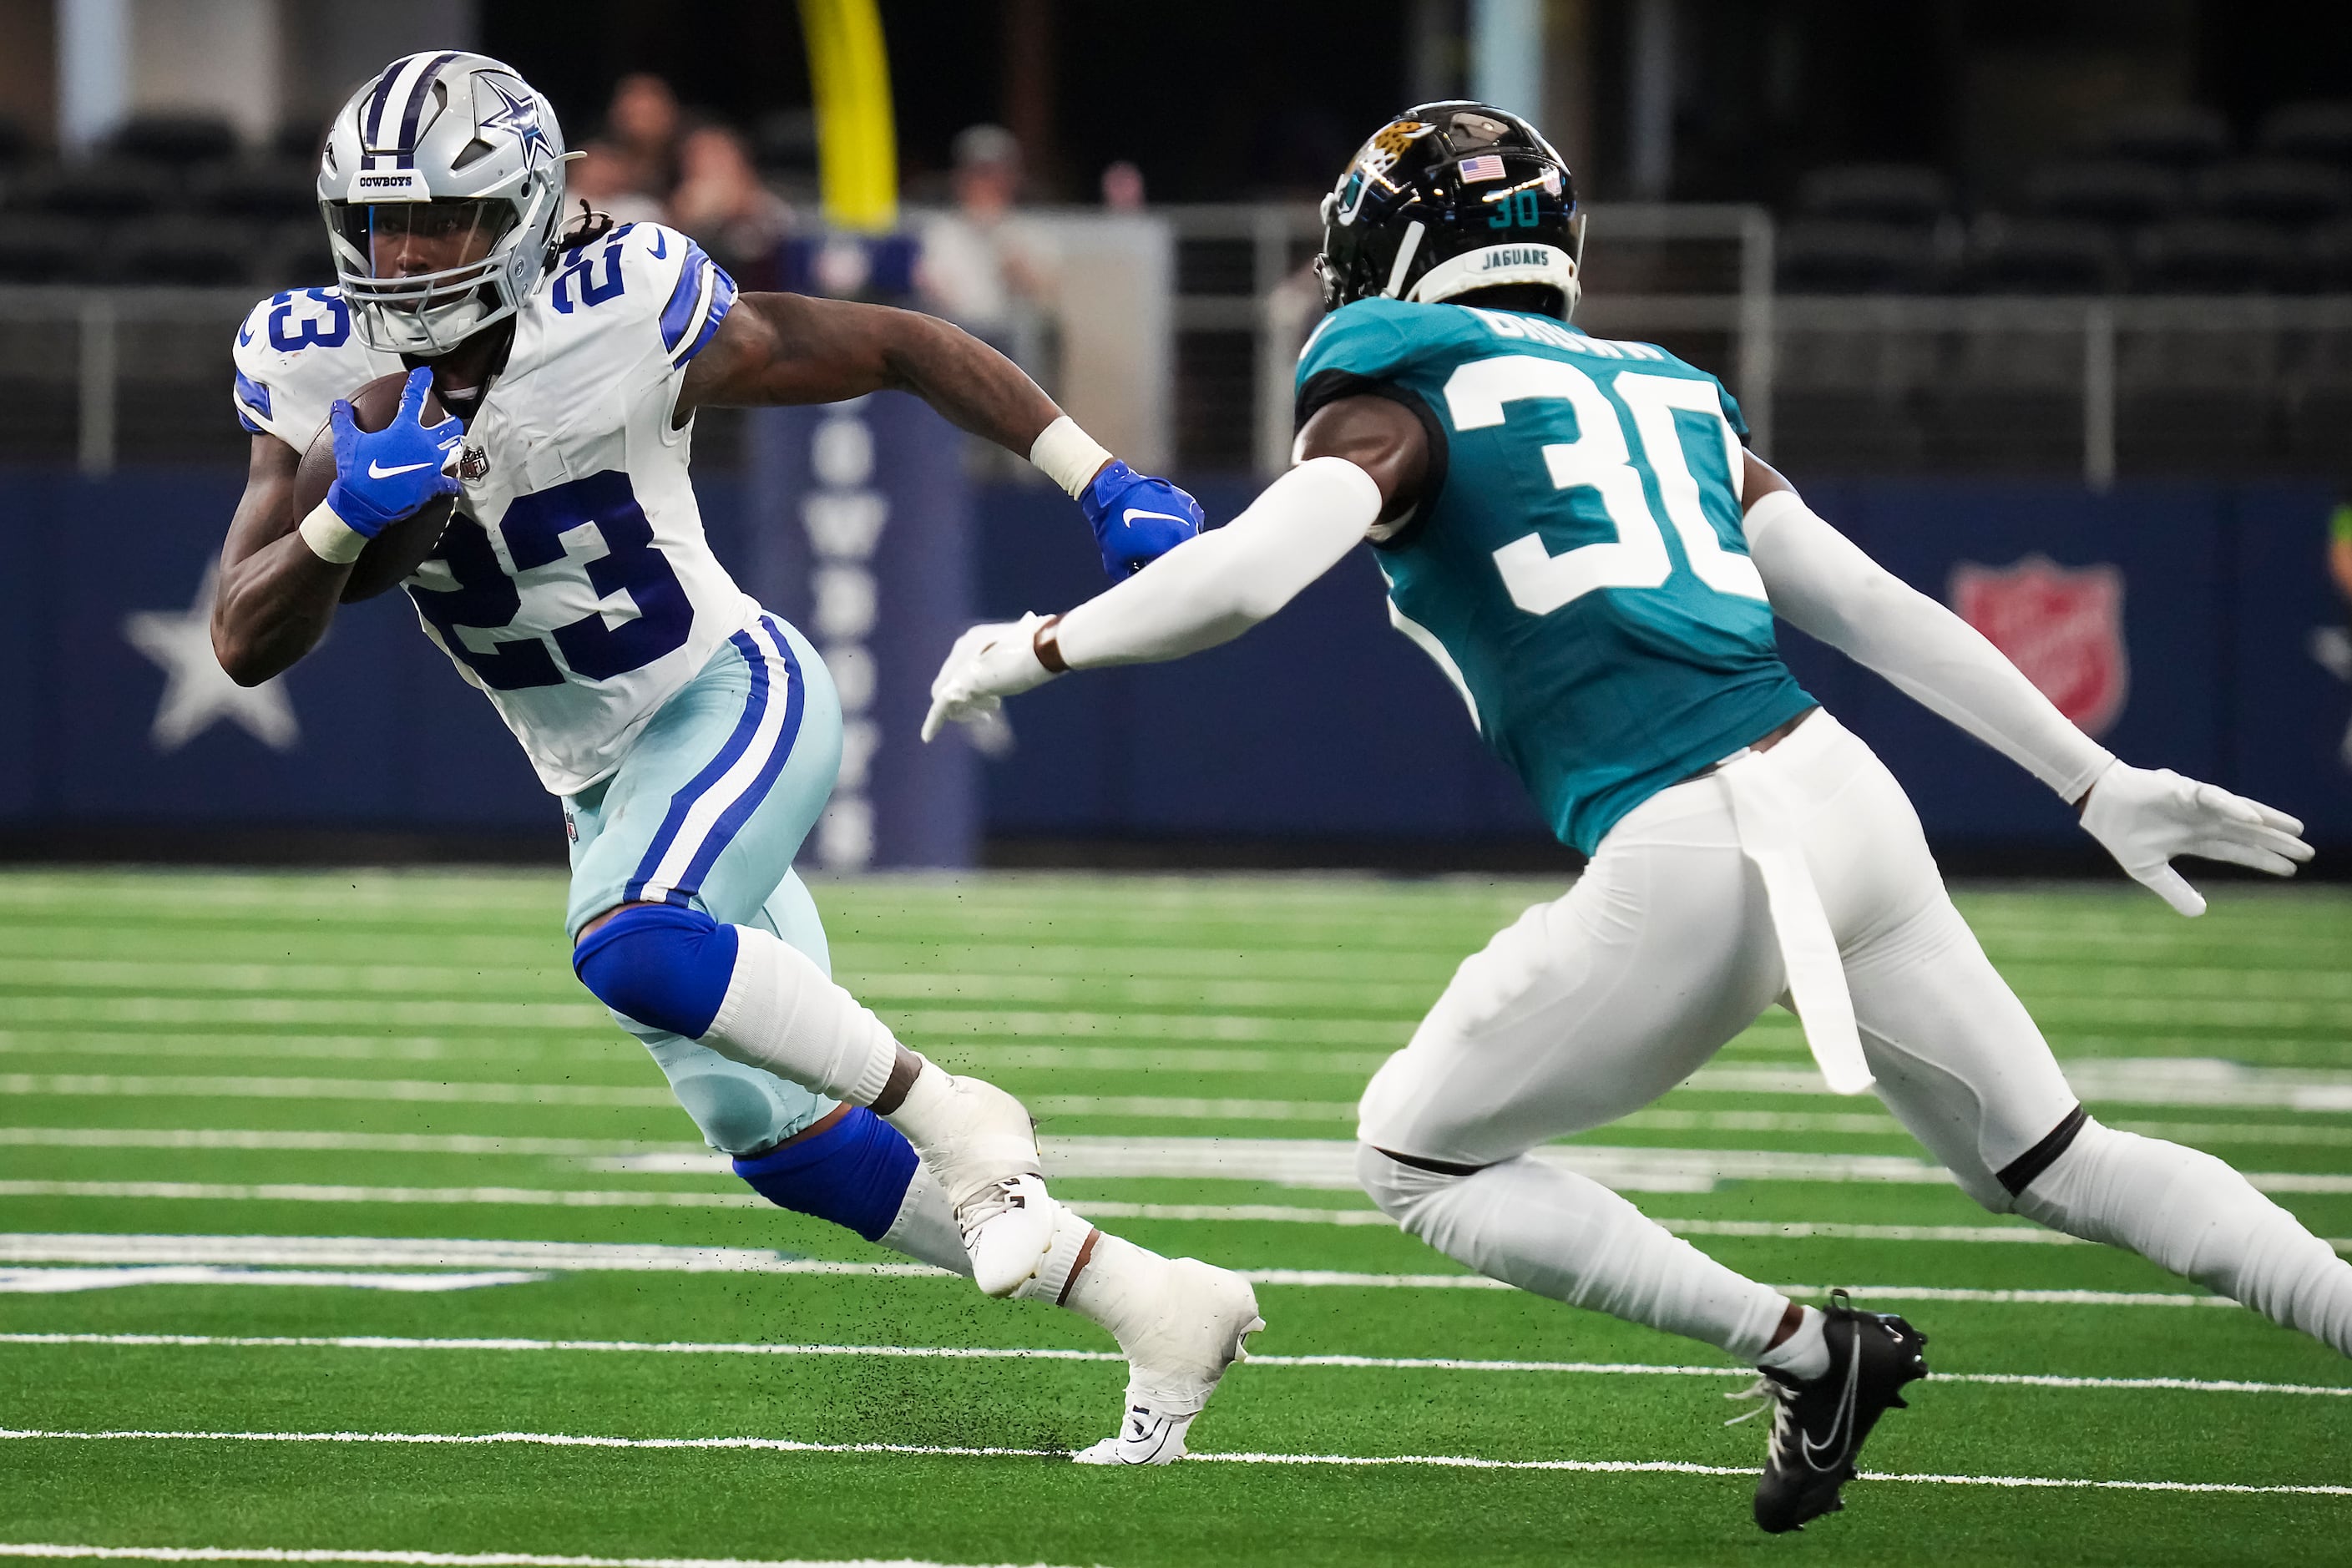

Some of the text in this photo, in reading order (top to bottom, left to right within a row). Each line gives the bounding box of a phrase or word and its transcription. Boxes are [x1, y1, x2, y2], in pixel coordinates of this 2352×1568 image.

[359, 176, 412, 187] COWBOYS
[1487, 190, 1540, 228] 30
[552, 222, 635, 314] 2
[1482, 248, 1549, 271] JAGUARS
[1443, 355, 1770, 616] 30
[407, 469, 695, 691] 23
